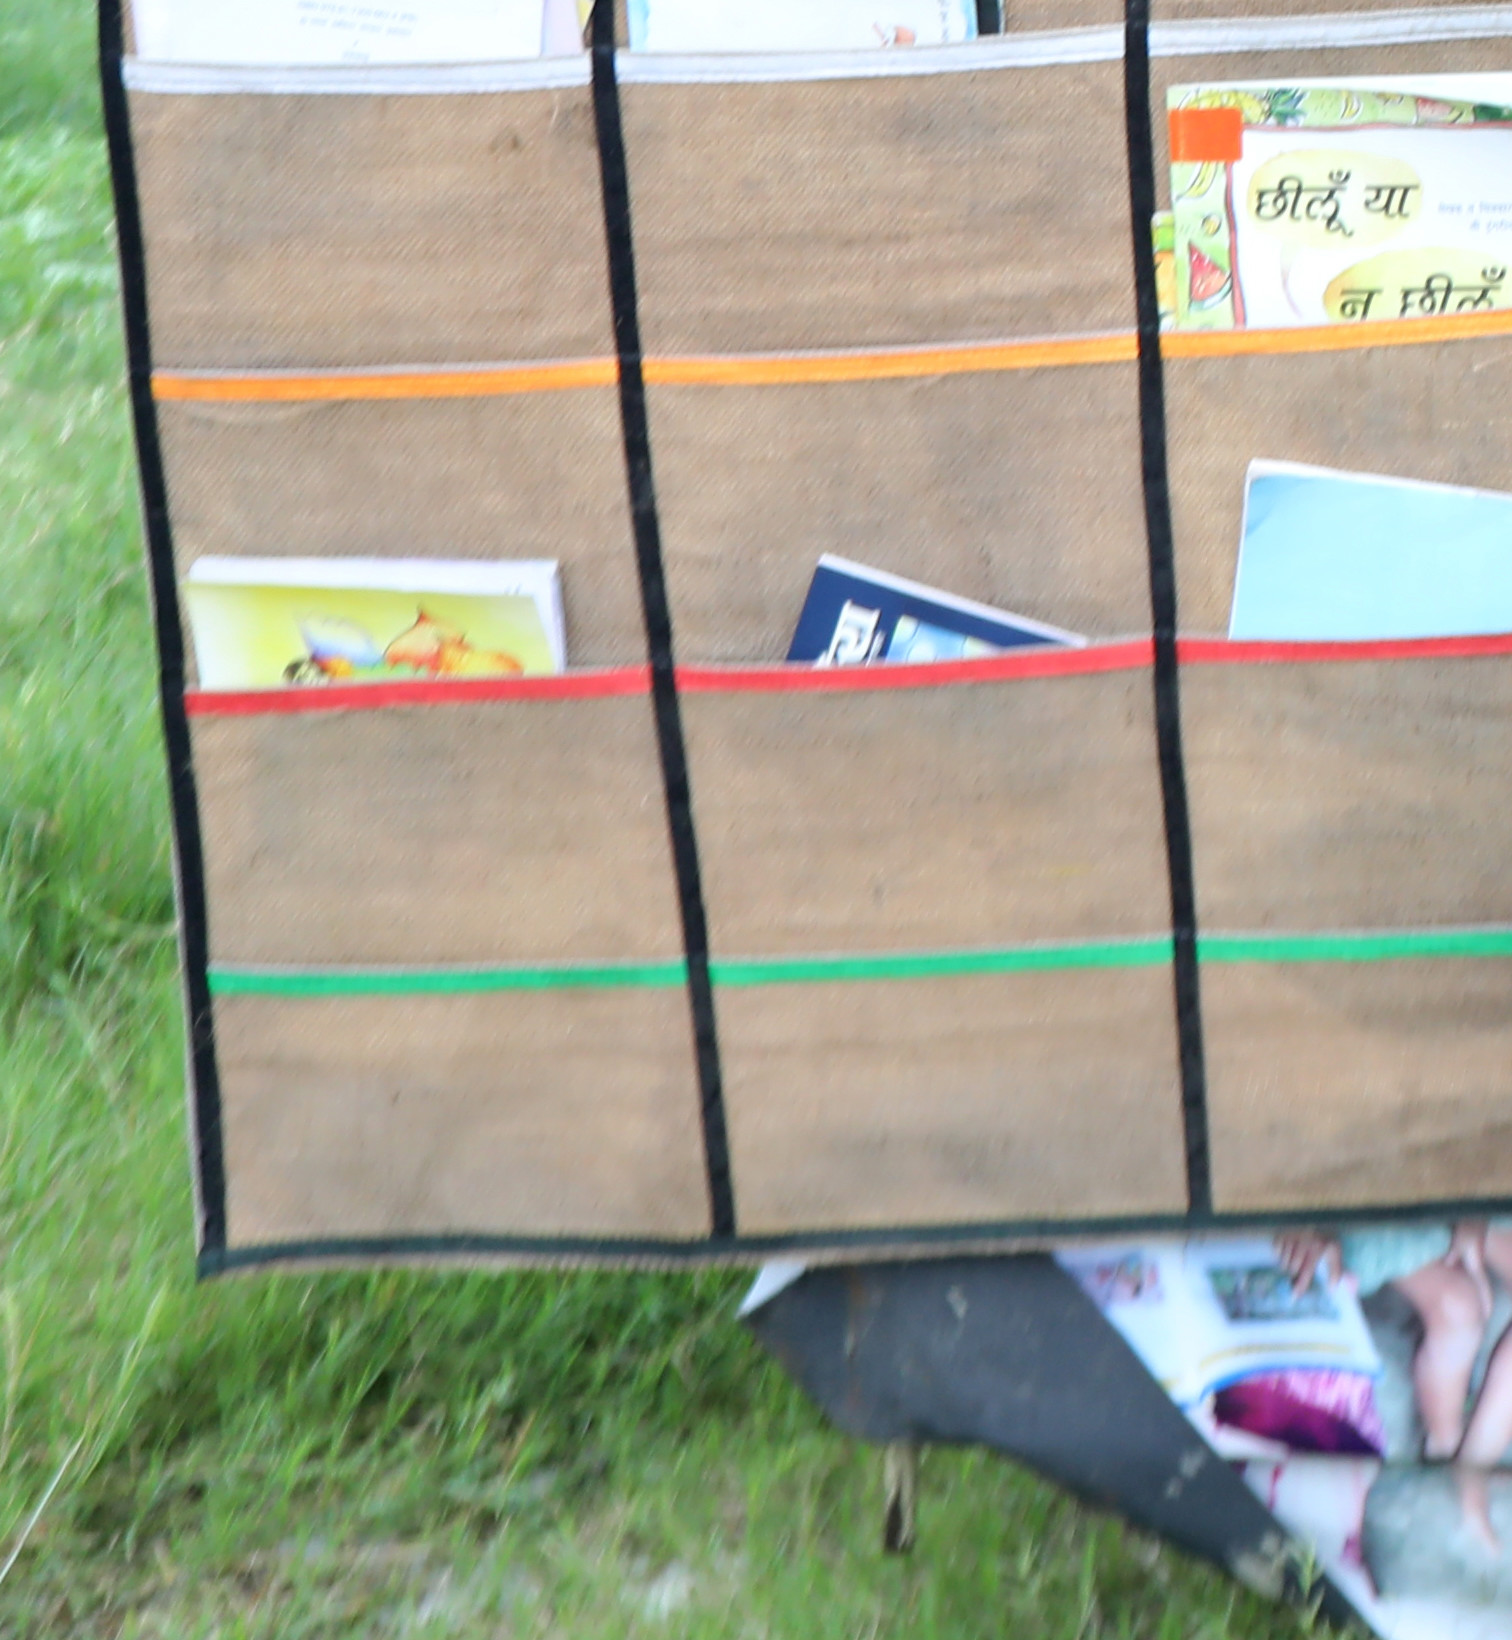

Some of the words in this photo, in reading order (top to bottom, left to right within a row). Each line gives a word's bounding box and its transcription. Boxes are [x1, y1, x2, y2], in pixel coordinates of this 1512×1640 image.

[1255, 169, 1353, 236] छीलूँ
[1363, 183, 1420, 219] या
[1339, 287, 1382, 321] न
[1399, 267, 1507, 314] छीलँ
